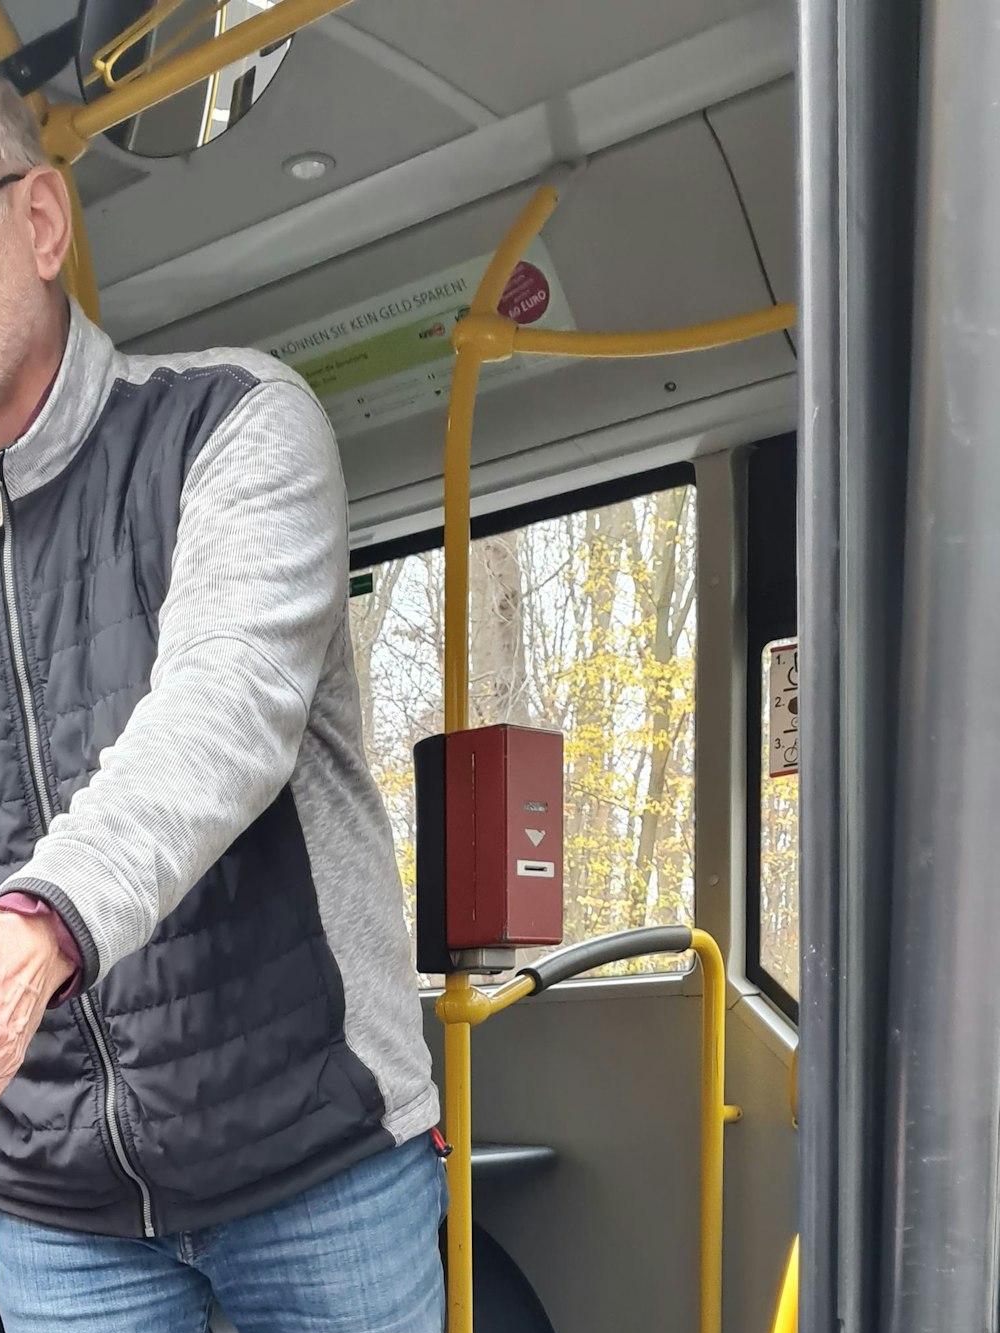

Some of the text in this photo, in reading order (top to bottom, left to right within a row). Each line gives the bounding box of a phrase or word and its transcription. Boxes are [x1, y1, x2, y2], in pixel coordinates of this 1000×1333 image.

[520, 290, 546, 312] EURO
[330, 322, 347, 339] SIE
[350, 311, 378, 331] KEIN
[379, 298, 412, 320] GELD
[412, 278, 468, 309] SPAREN!
[776, 655, 786, 665] 1.
[774, 696, 785, 708] 2.
[774, 738, 785, 749] 3.
